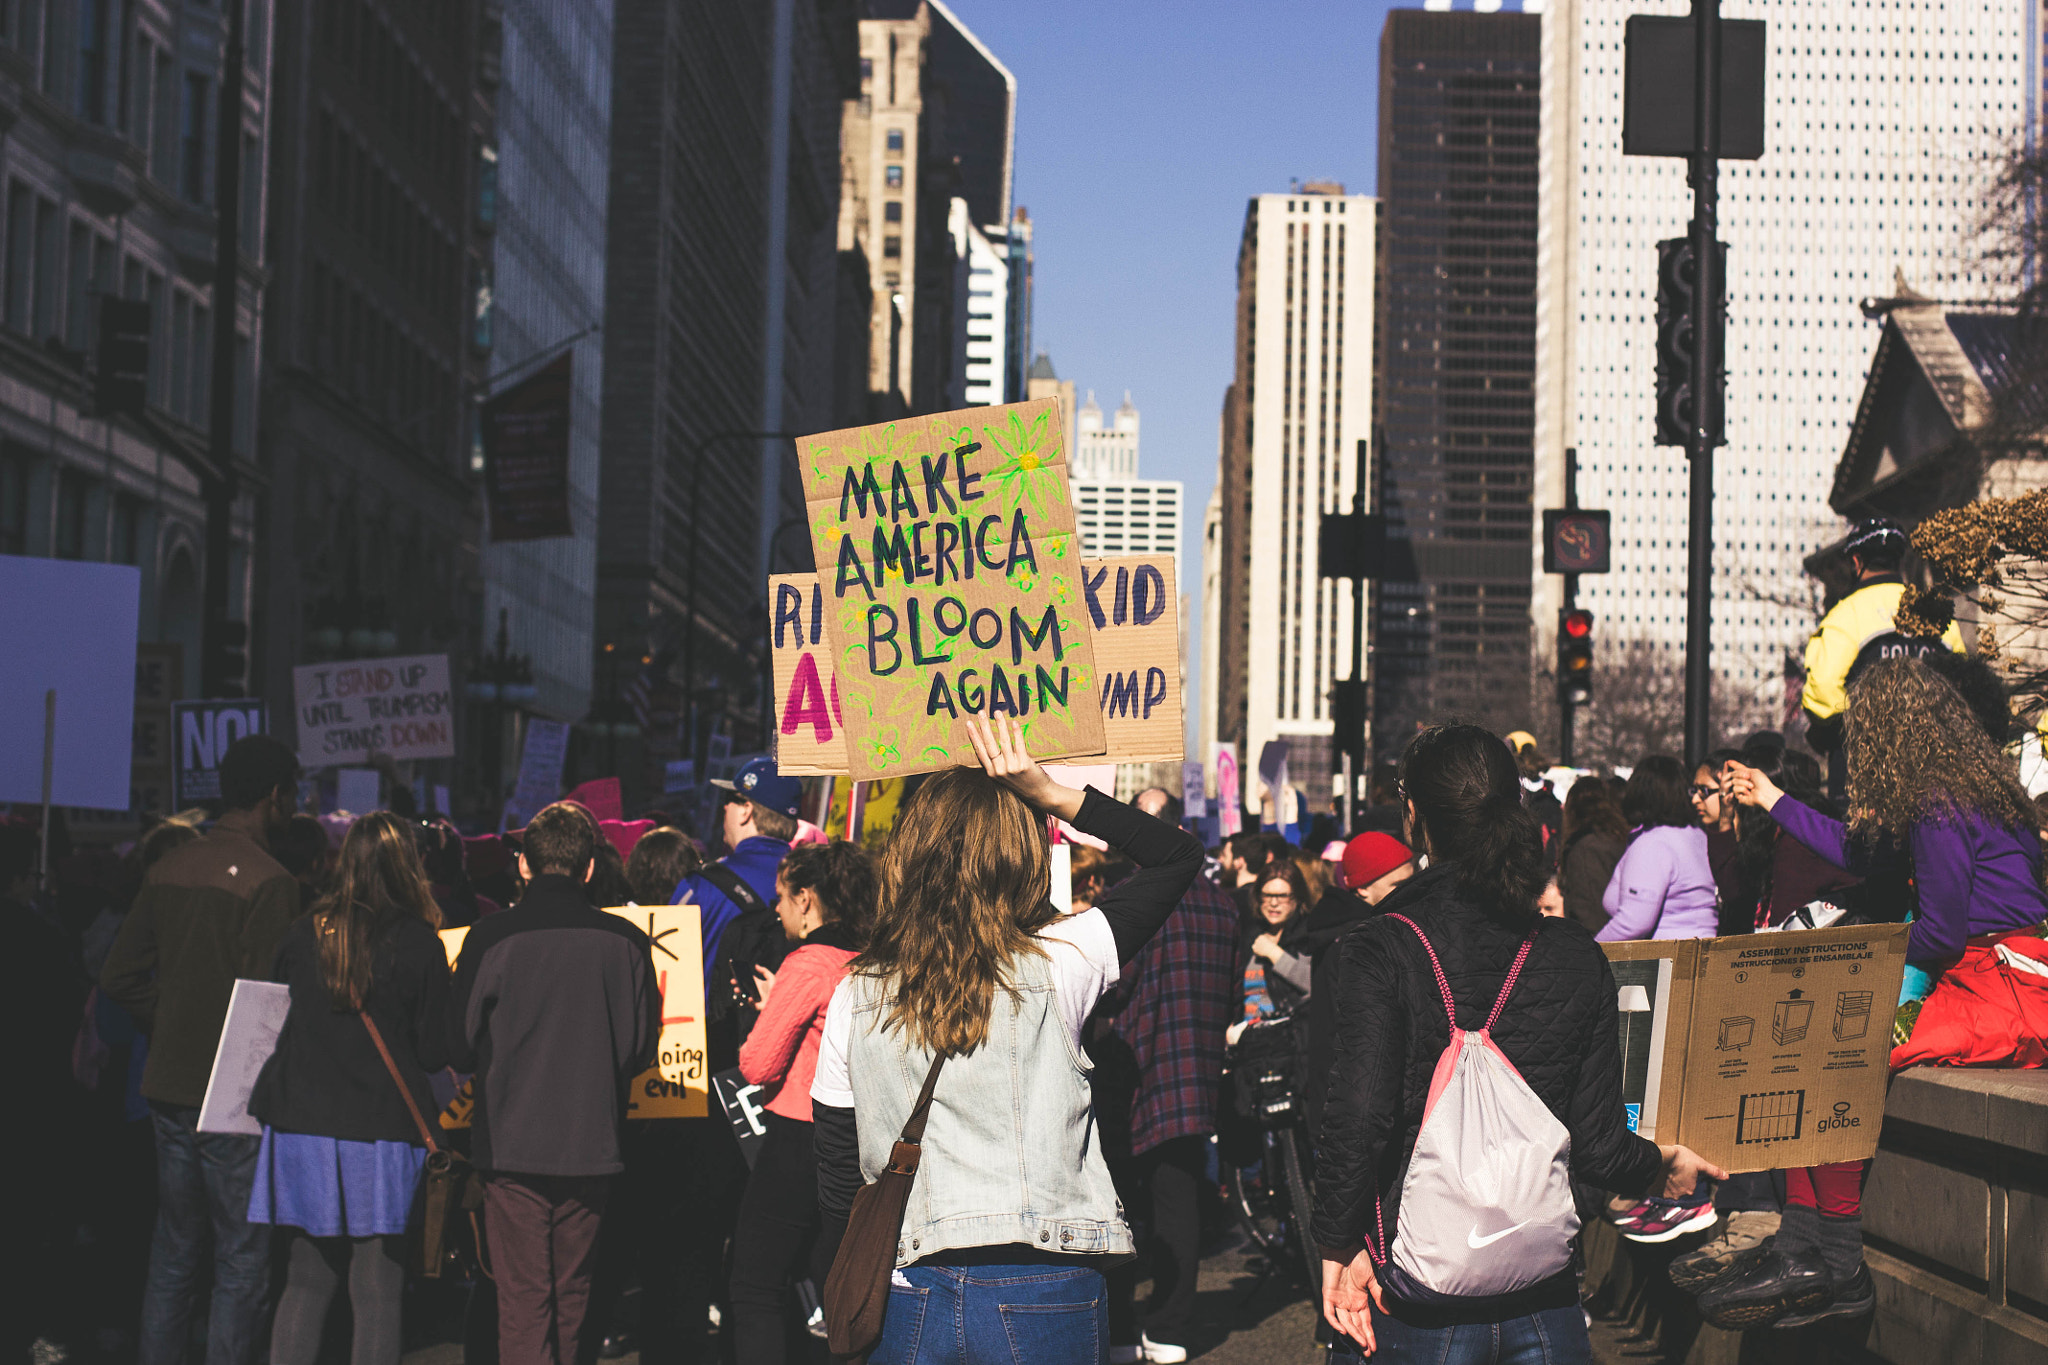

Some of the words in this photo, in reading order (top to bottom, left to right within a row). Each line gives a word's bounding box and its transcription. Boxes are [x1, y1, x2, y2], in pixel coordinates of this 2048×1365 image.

[840, 441, 985, 523] MAKE
[834, 508, 1039, 601] AMERICA
[867, 596, 1065, 677] BLOOM
[313, 670, 331, 700] I
[334, 667, 395, 698] STAND
[398, 663, 429, 689] UP
[926, 663, 1070, 720] AGAIN
[302, 701, 353, 728] UNTIL
[363, 690, 450, 720] TRUMPISM
[322, 723, 387, 754] STANDS
[390, 721, 447, 748] DOWN
[1730, 956, 1798, 969] INSTRUCCIONES
[1799, 956, 1811, 964] DE
[1813, 951, 1874, 963] ENSAMBLAJE
[1738, 946, 1792, 959] ASSEMBLY
[1793, 941, 1868, 955] INSTRUCTIONS
[644, 1071, 688, 1100] evil
[1817, 1115, 1860, 1133] globe
